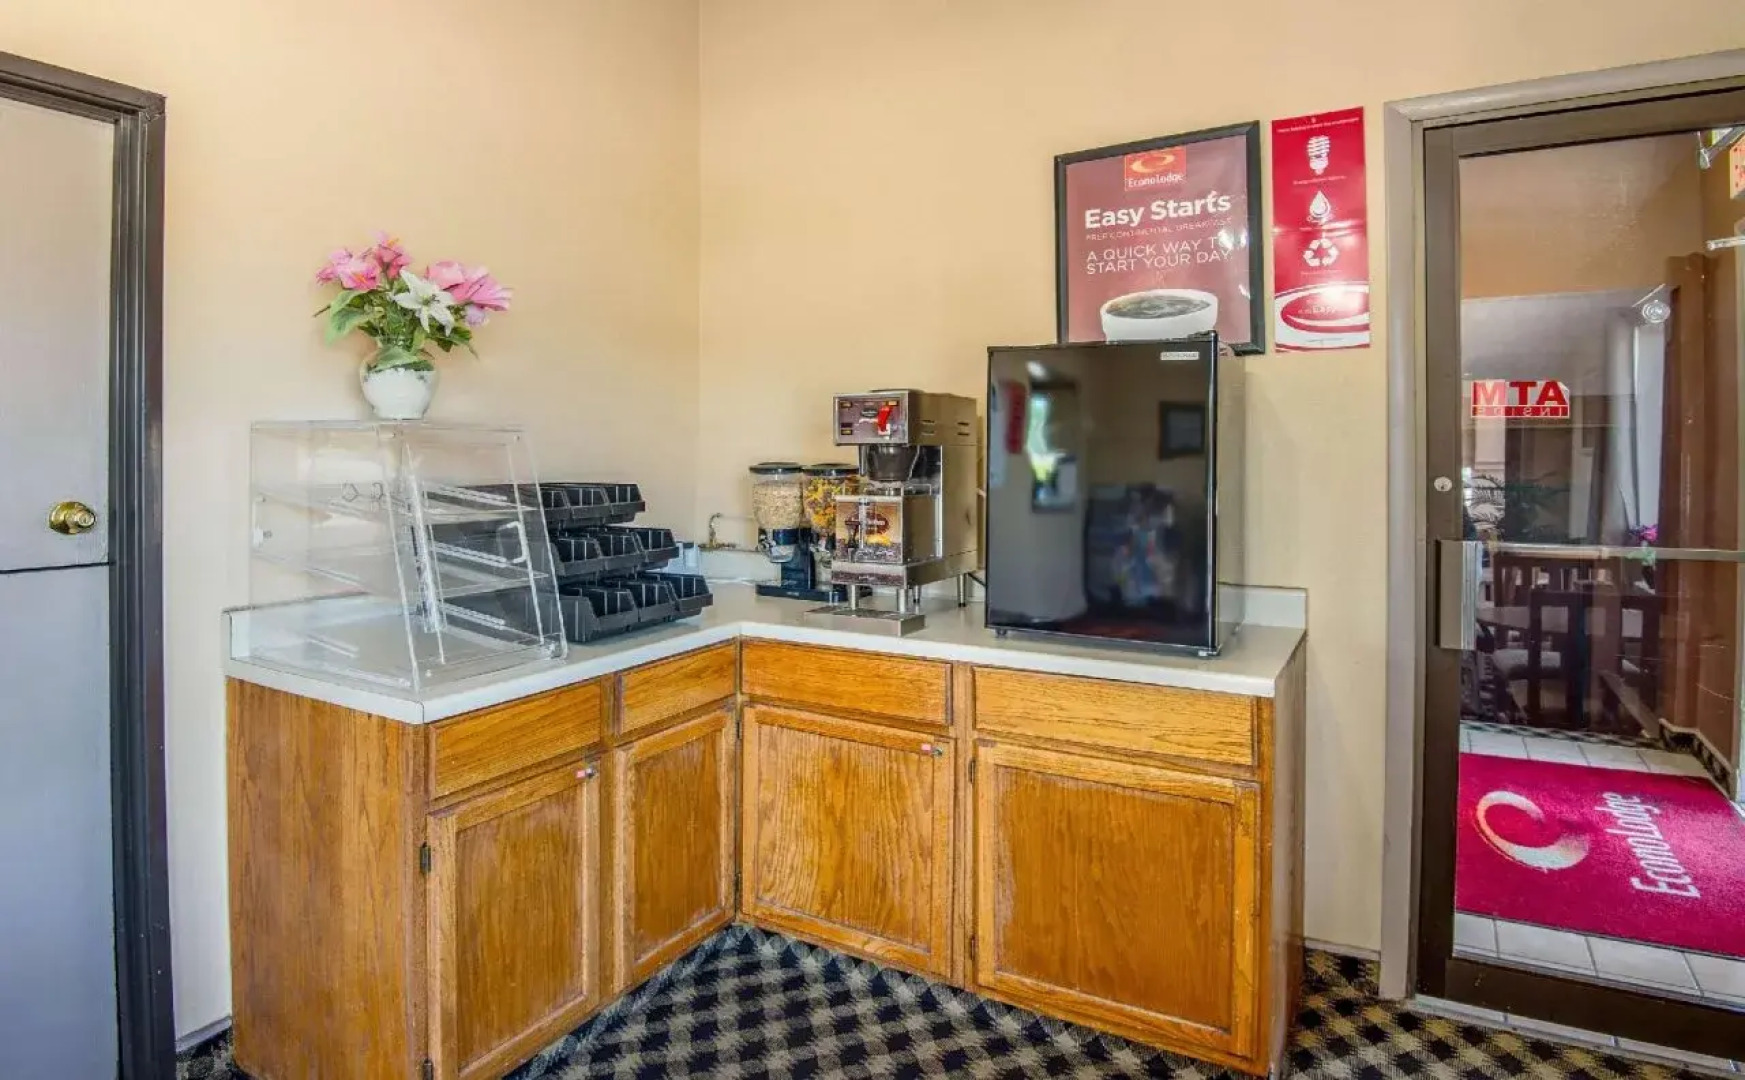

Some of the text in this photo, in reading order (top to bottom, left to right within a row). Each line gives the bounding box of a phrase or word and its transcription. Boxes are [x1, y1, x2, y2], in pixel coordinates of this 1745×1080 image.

[1085, 191, 1232, 229] Easy Starts
[1087, 251, 1098, 262] A
[1103, 244, 1157, 261] QUICK
[1162, 238, 1202, 253] WAY
[1087, 258, 1137, 275] START
[1143, 253, 1190, 269] YOUR
[1594, 792, 1701, 899] EconoLodge
